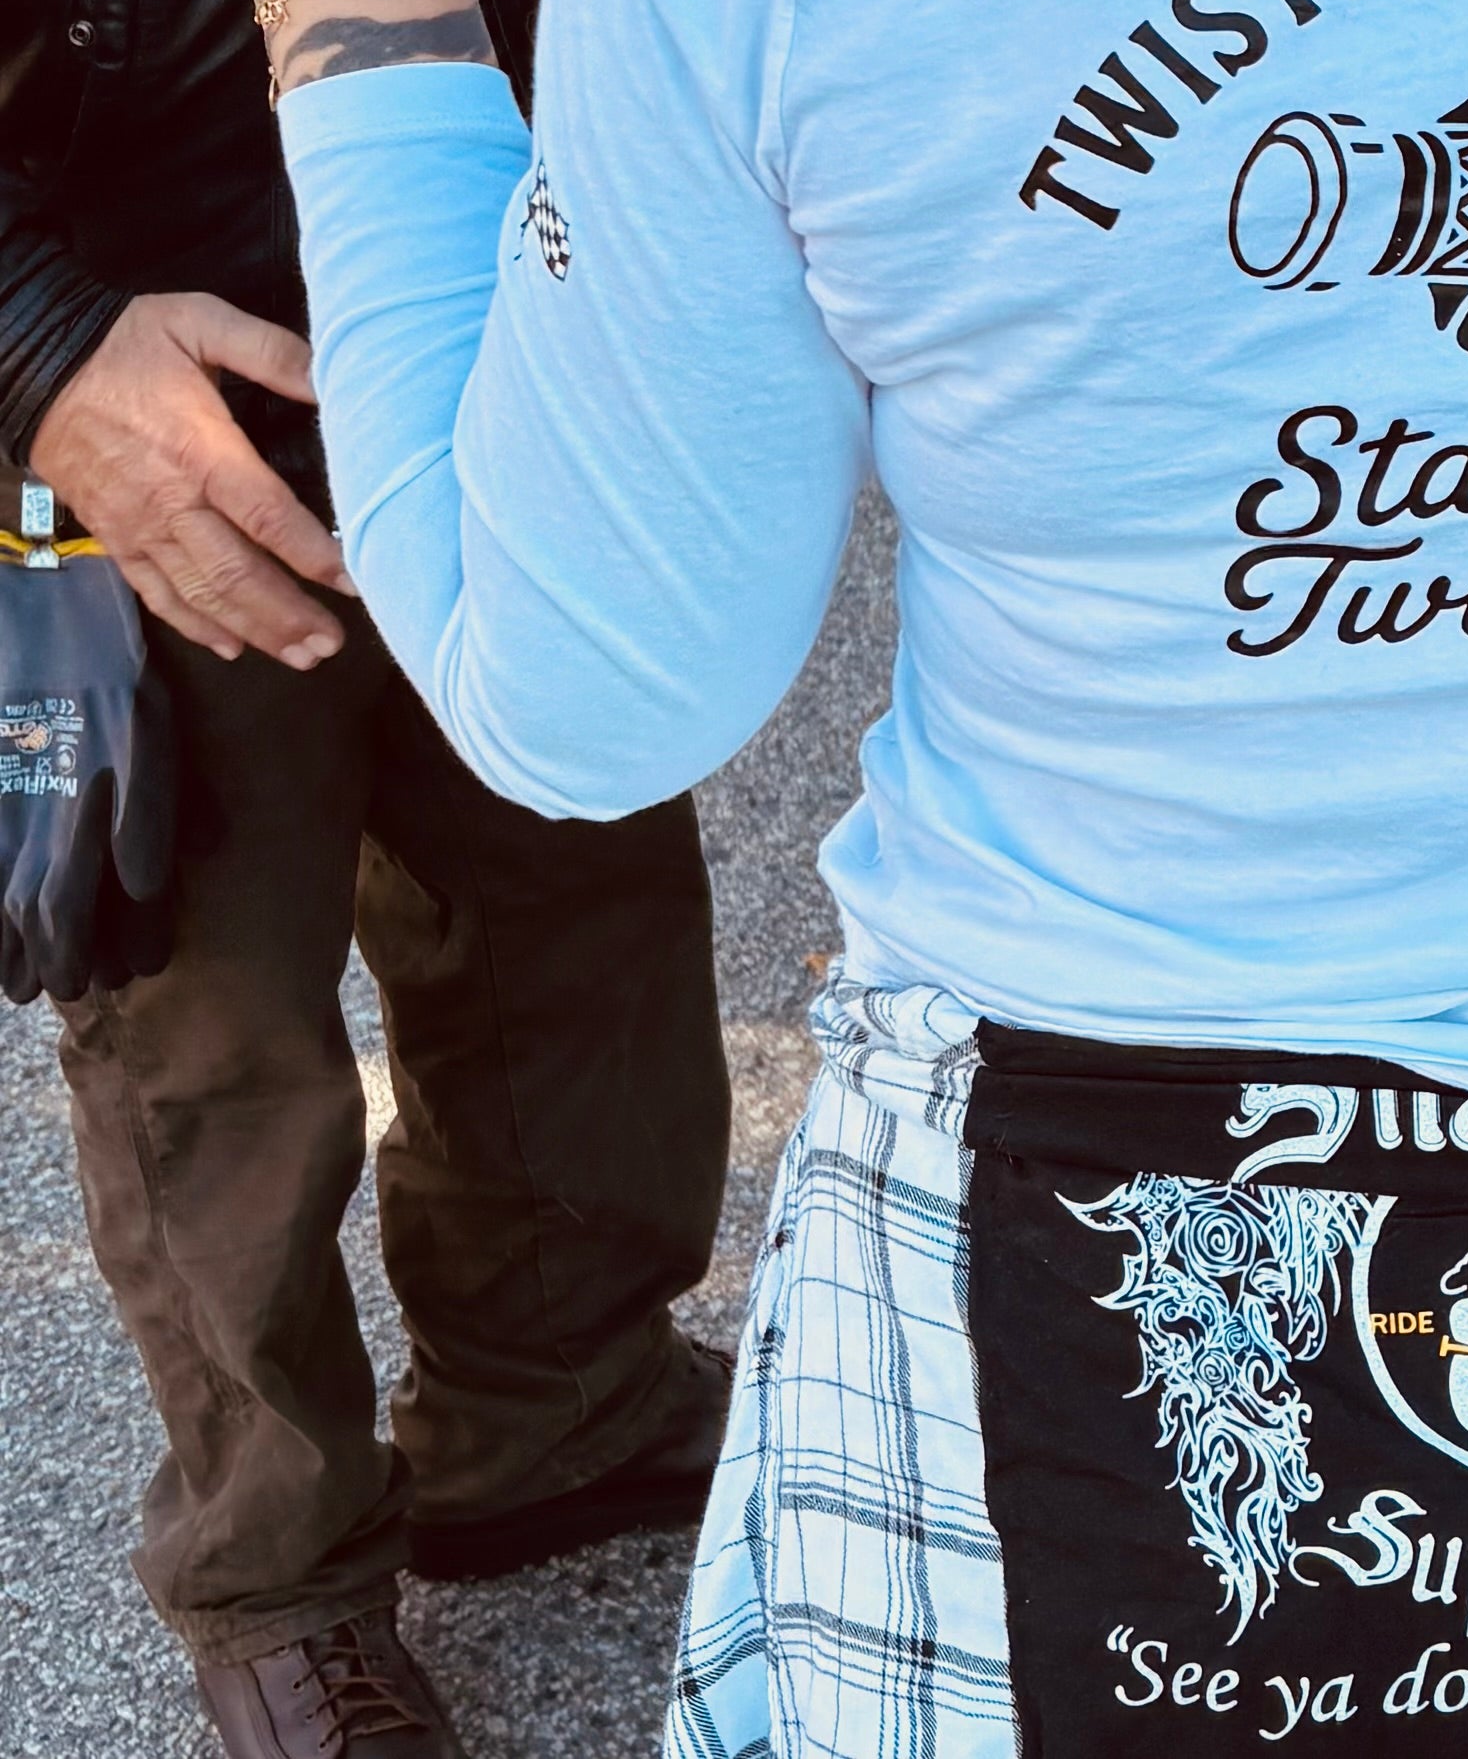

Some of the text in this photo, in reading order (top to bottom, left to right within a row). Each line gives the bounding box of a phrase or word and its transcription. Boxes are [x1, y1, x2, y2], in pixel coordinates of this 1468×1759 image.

[1368, 1310, 1435, 1335] RIDE
[1105, 1624, 1240, 1712] “See
[1257, 1674, 1359, 1741] ya
